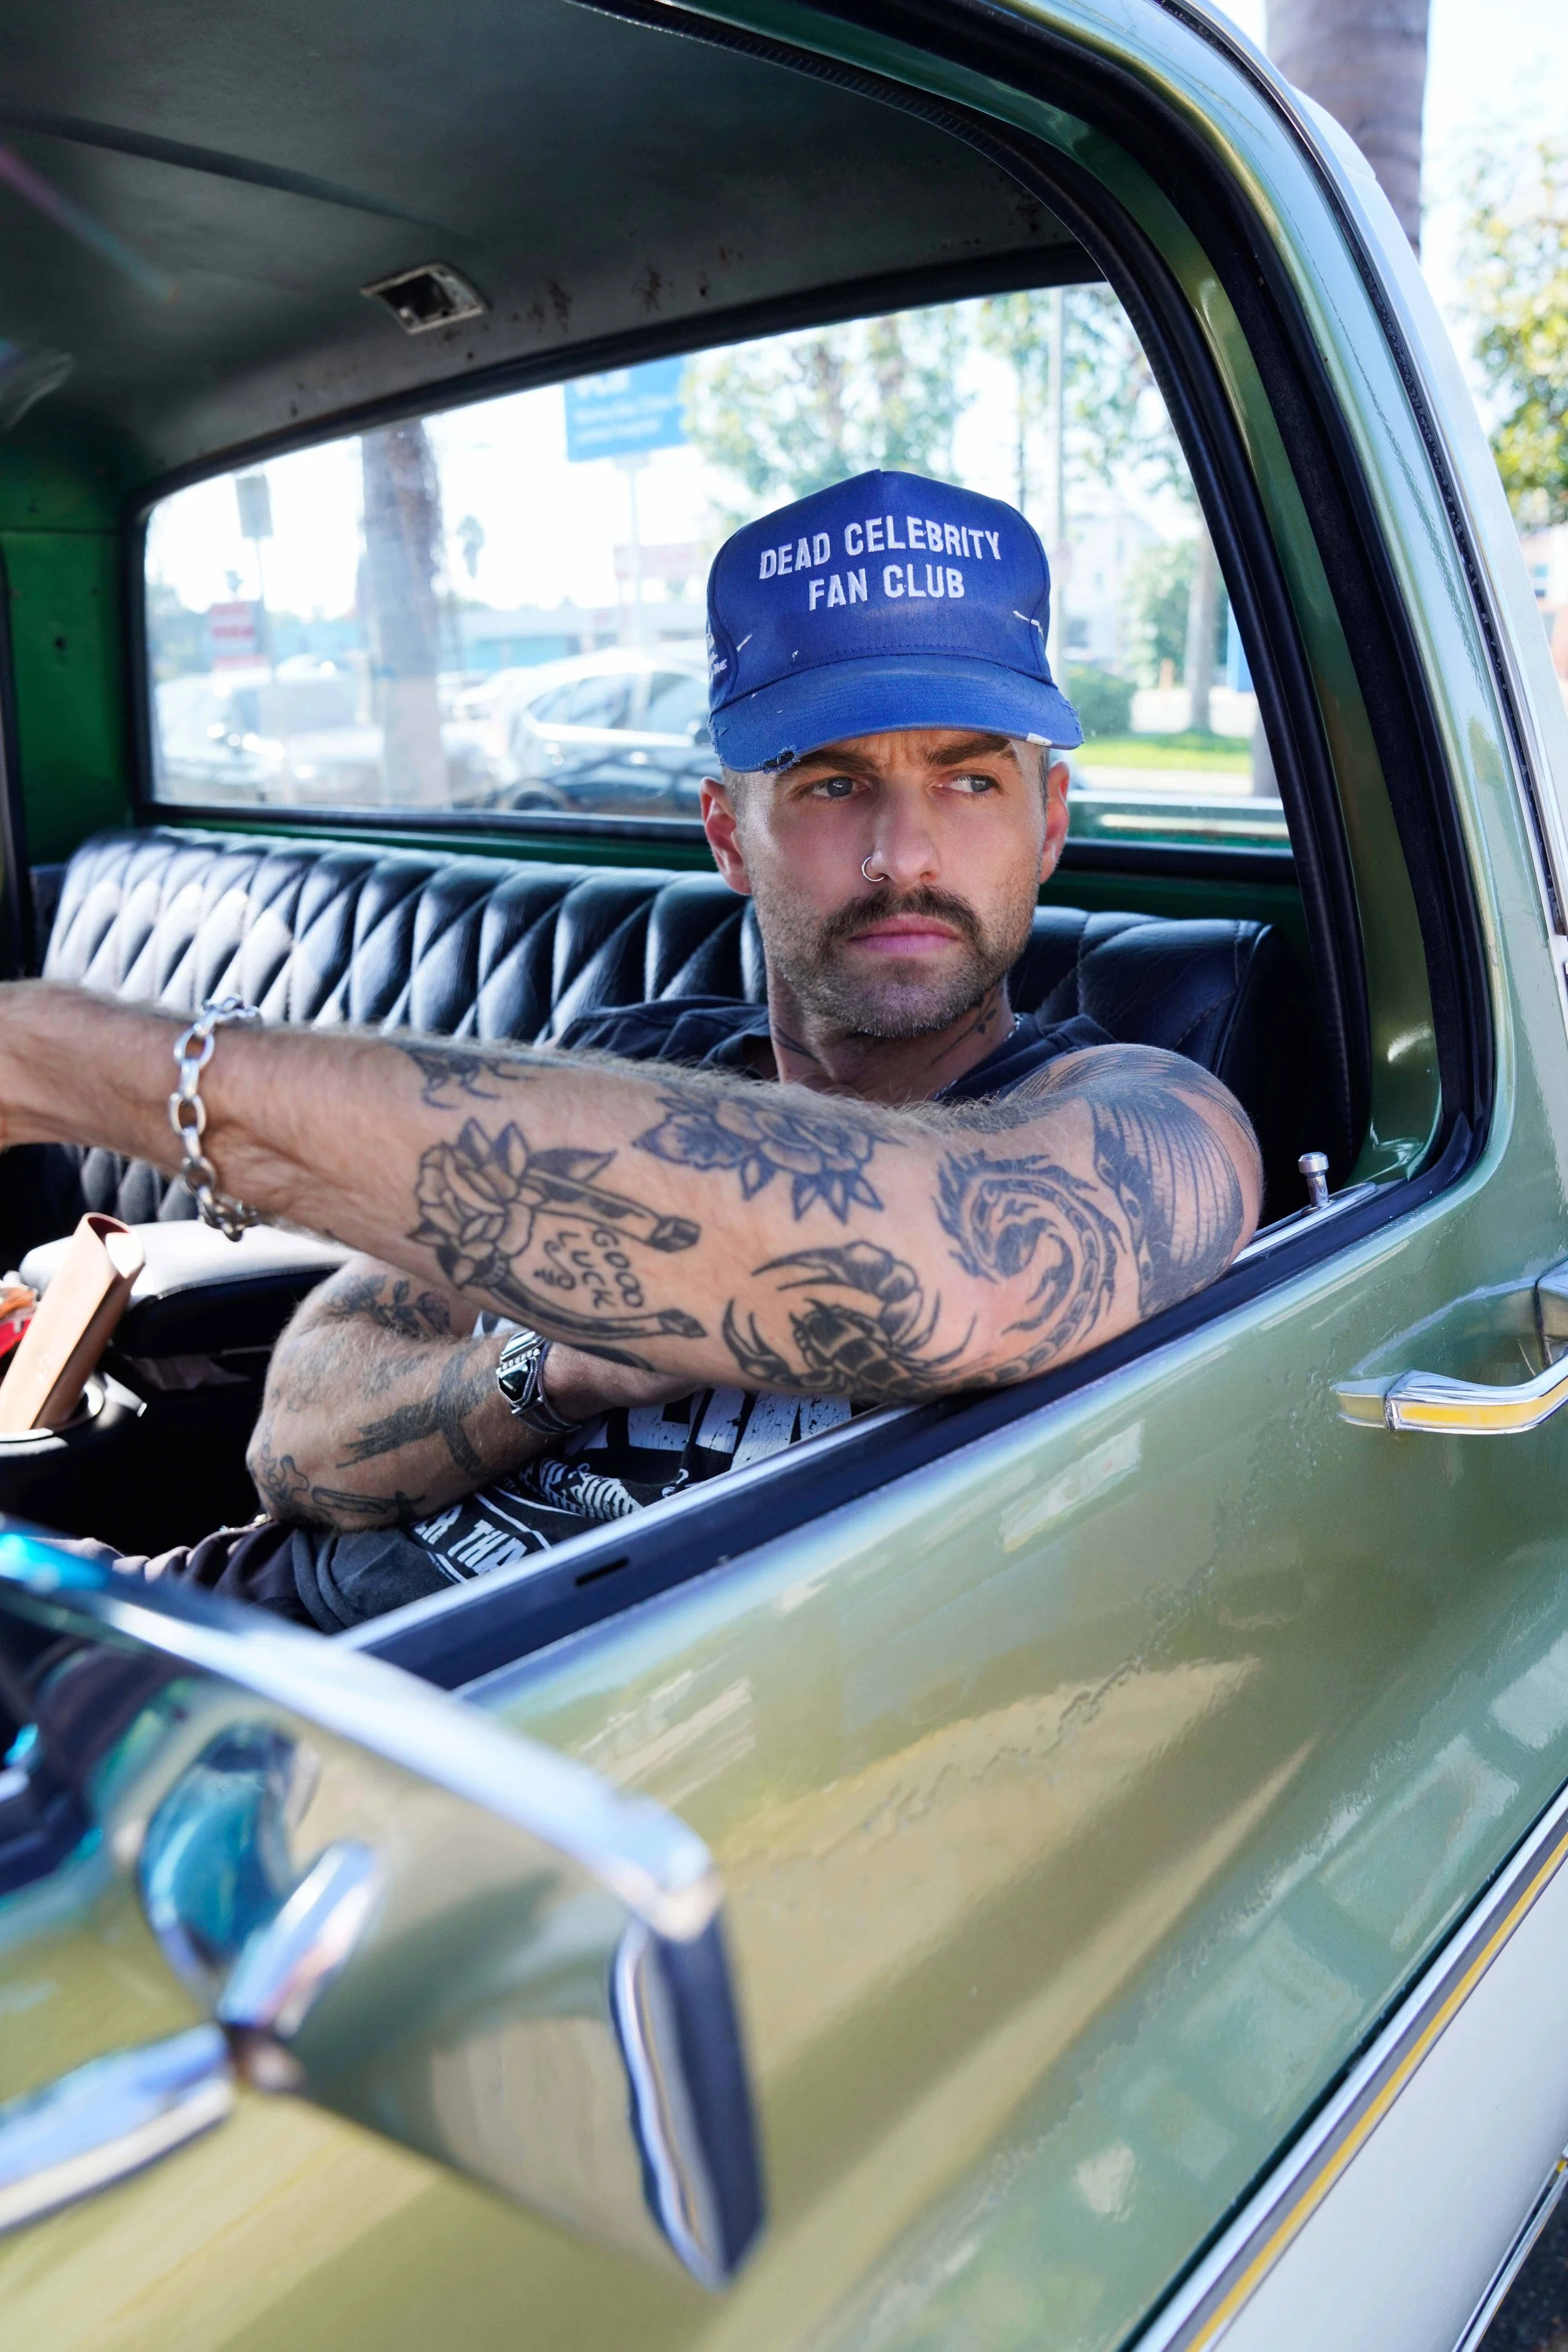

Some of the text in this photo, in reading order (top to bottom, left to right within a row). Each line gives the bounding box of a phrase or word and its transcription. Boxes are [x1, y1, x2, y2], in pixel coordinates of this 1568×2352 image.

[759, 516, 1002, 580] DEAD CELEBRITY
[809, 564, 965, 611] FAN CLUB
[557, 1231, 617, 1309] LUCK
